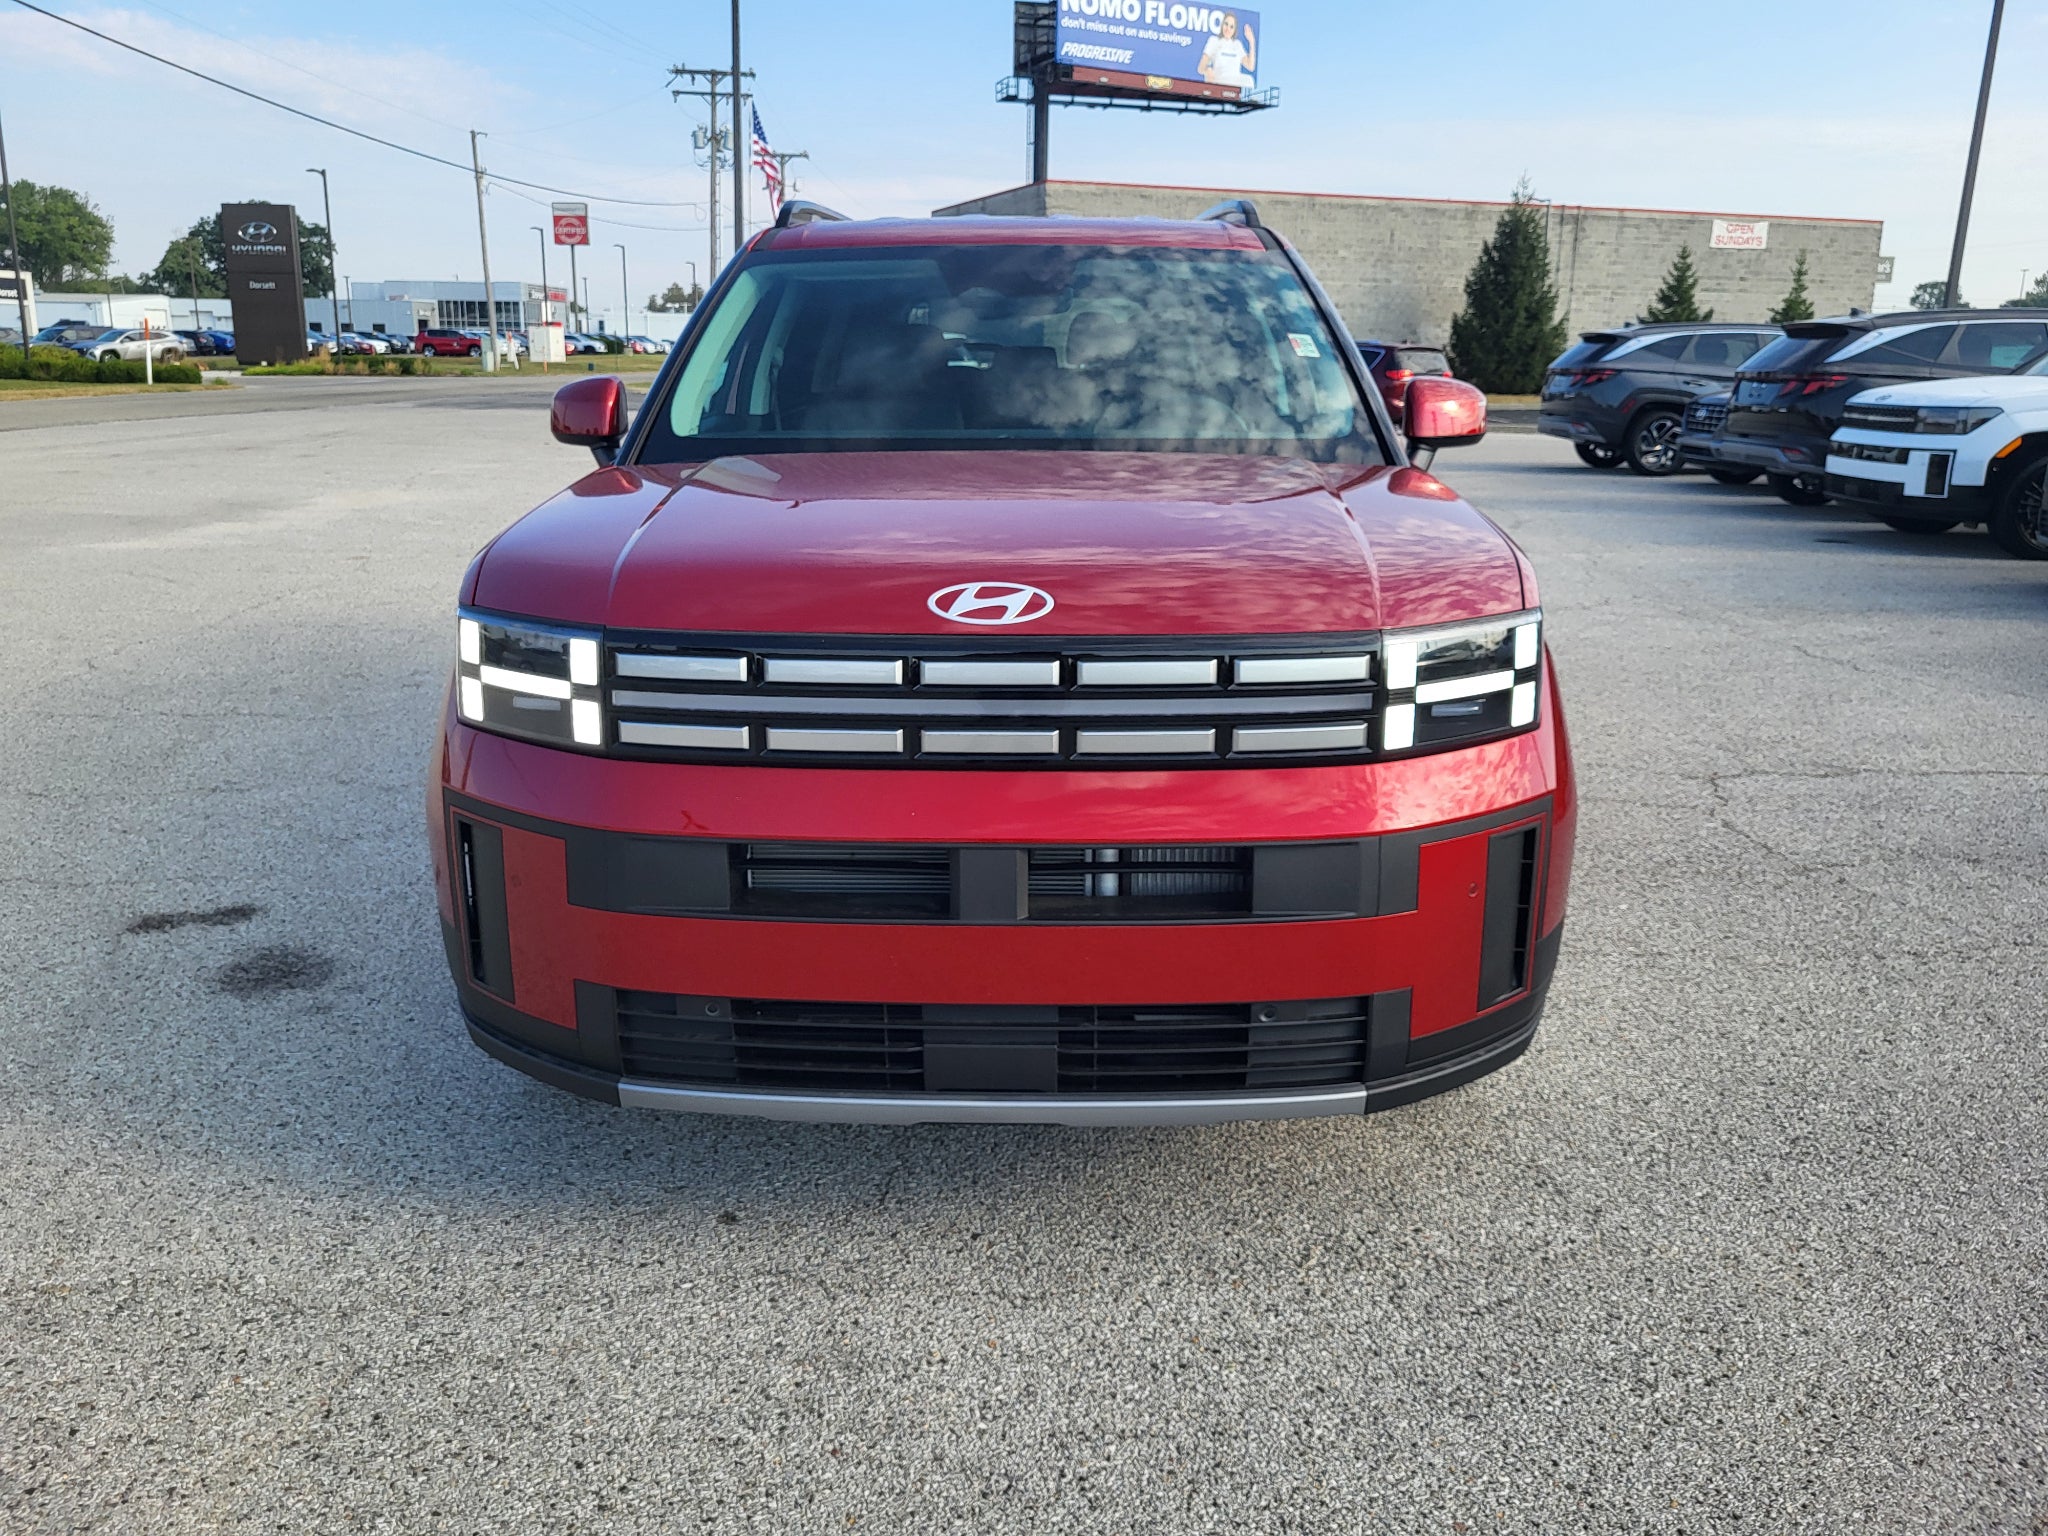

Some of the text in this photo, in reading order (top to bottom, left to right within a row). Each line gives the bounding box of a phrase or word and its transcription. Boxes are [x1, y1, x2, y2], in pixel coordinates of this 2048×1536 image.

[1144, 0, 1224, 35] FLOMO
[1061, 16, 1193, 47] don't miss out on auto savings
[1061, 41, 1135, 65] PROGRESSIVE
[1714, 235, 1763, 246] SUNDAYS
[1726, 223, 1755, 234] OPEN
